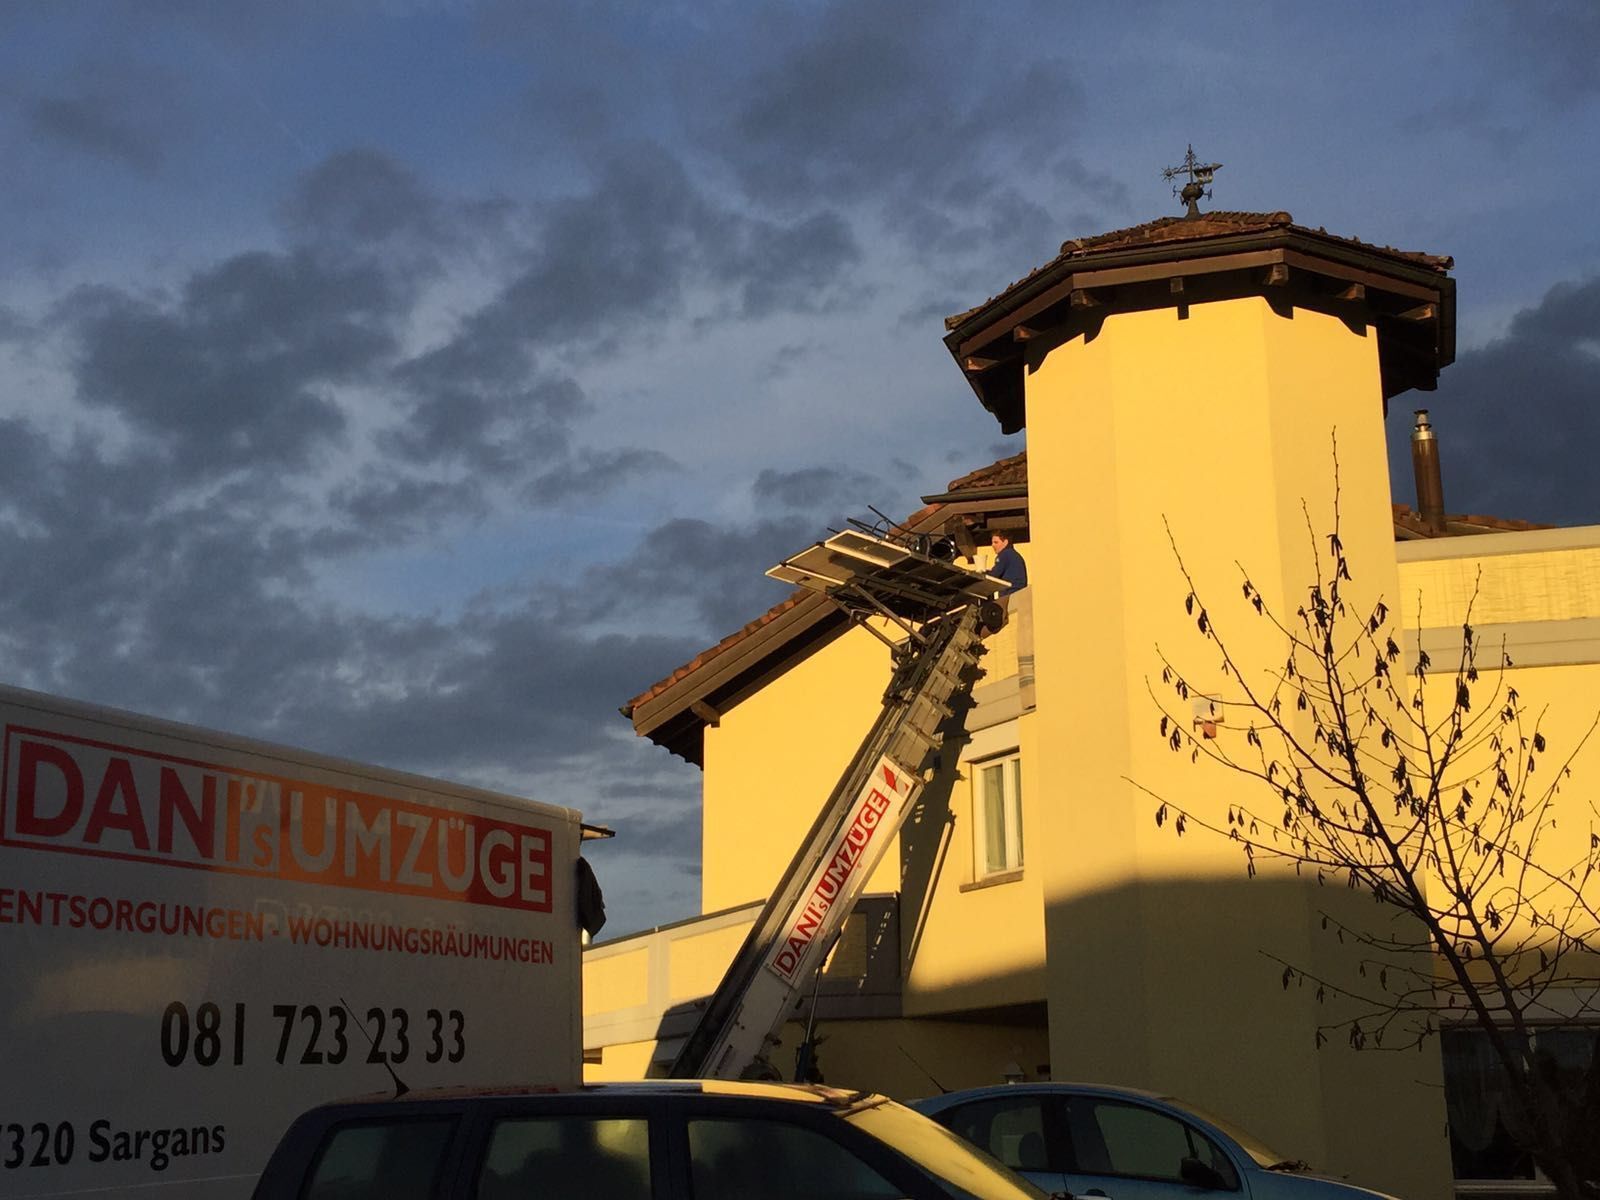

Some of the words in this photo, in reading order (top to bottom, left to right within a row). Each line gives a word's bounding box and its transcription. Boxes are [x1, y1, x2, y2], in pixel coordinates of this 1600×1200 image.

[289, 790, 547, 903] UMZÜGE
[818, 790, 889, 898] UMZÜGE
[0, 888, 264, 942] ENTSORGUNGEN
[287, 915, 554, 965] WOHNUNGSRÄUMUNGEN
[160, 1001, 246, 1067] 081
[272, 1004, 348, 1064] 723
[366, 1007, 410, 1064] 23
[425, 1008, 466, 1063] 33
[0, 1121, 74, 1169] 320
[88, 1119, 225, 1171] Sargans
